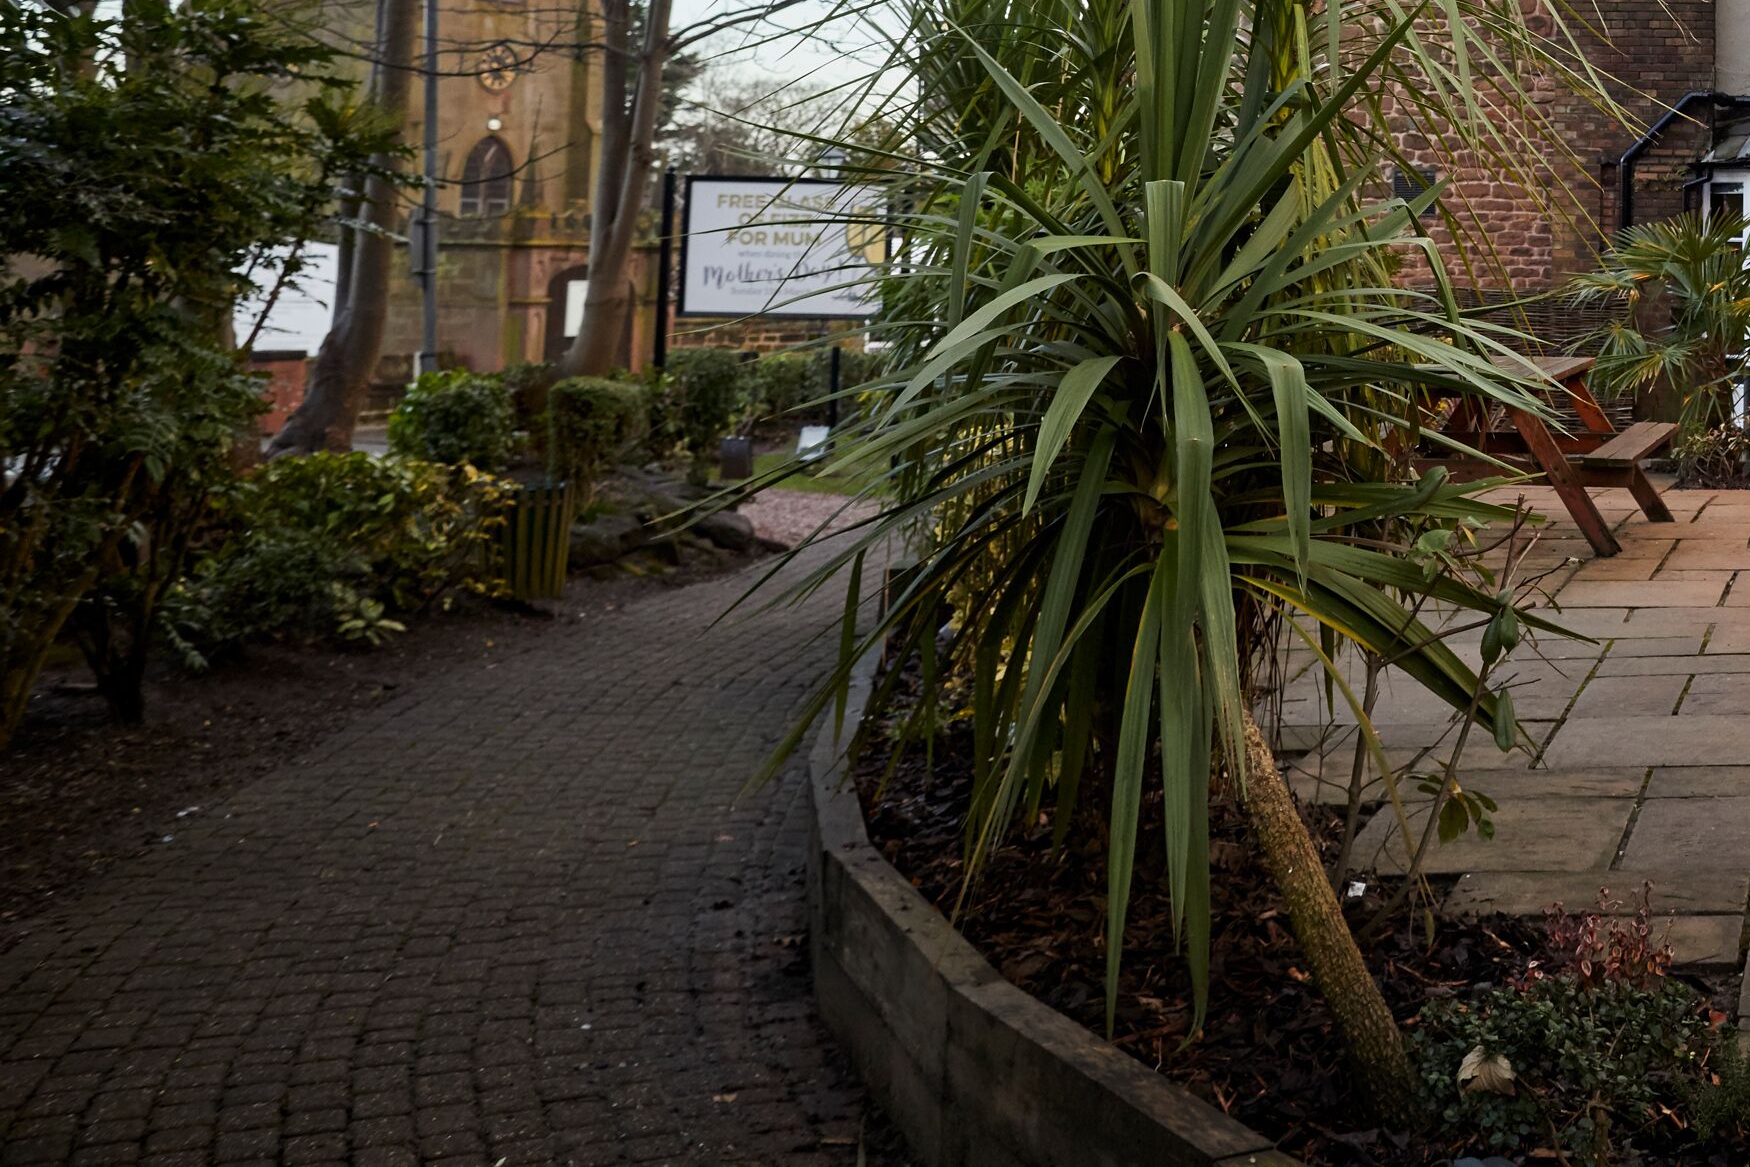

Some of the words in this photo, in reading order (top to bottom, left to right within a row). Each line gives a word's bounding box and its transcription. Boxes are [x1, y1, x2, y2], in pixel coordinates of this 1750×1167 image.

[717, 194, 766, 209] FREE
[728, 231, 768, 246] FOR
[773, 231, 822, 246] MUM
[703, 262, 784, 289] Mother's
